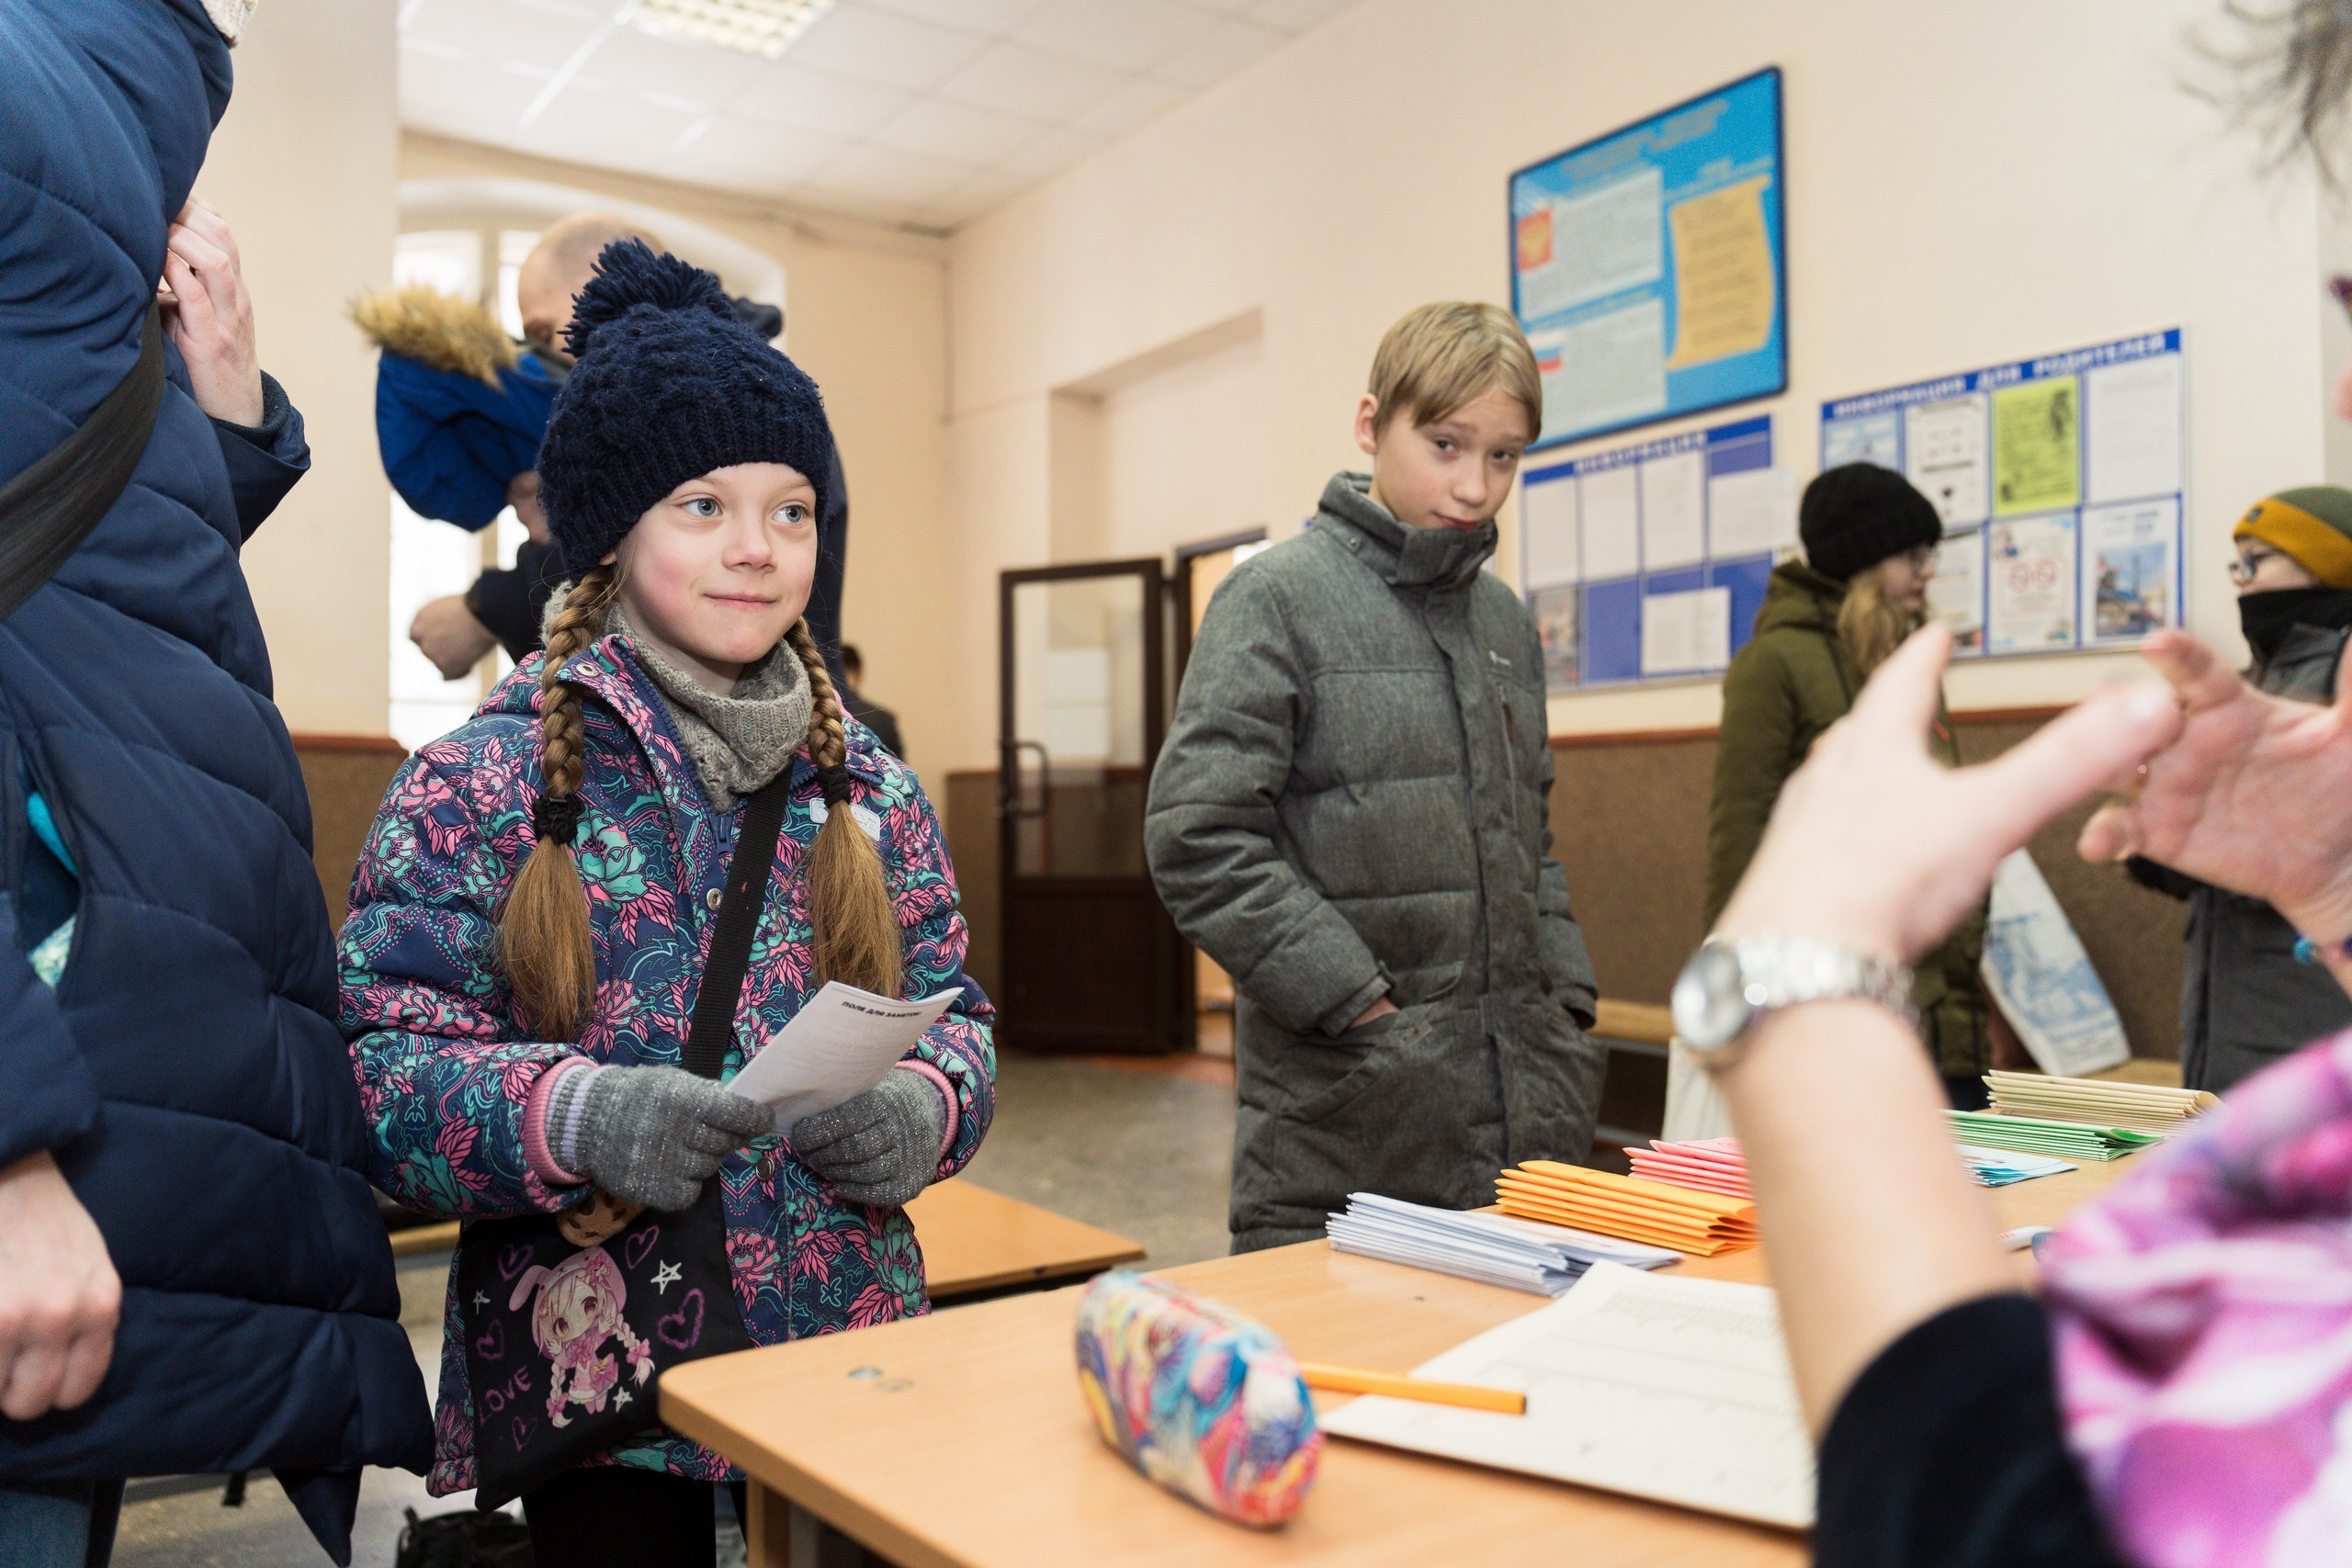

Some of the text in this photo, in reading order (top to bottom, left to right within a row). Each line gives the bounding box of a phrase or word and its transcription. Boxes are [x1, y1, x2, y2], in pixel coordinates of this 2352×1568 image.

[1975, 364, 2022, 391] ДЛЯ
[842, 1000, 865, 1012] ПОЛЕ
[866, 1009, 886, 1017] ДЛЯ
[478, 1365, 532, 1427] LOVE
